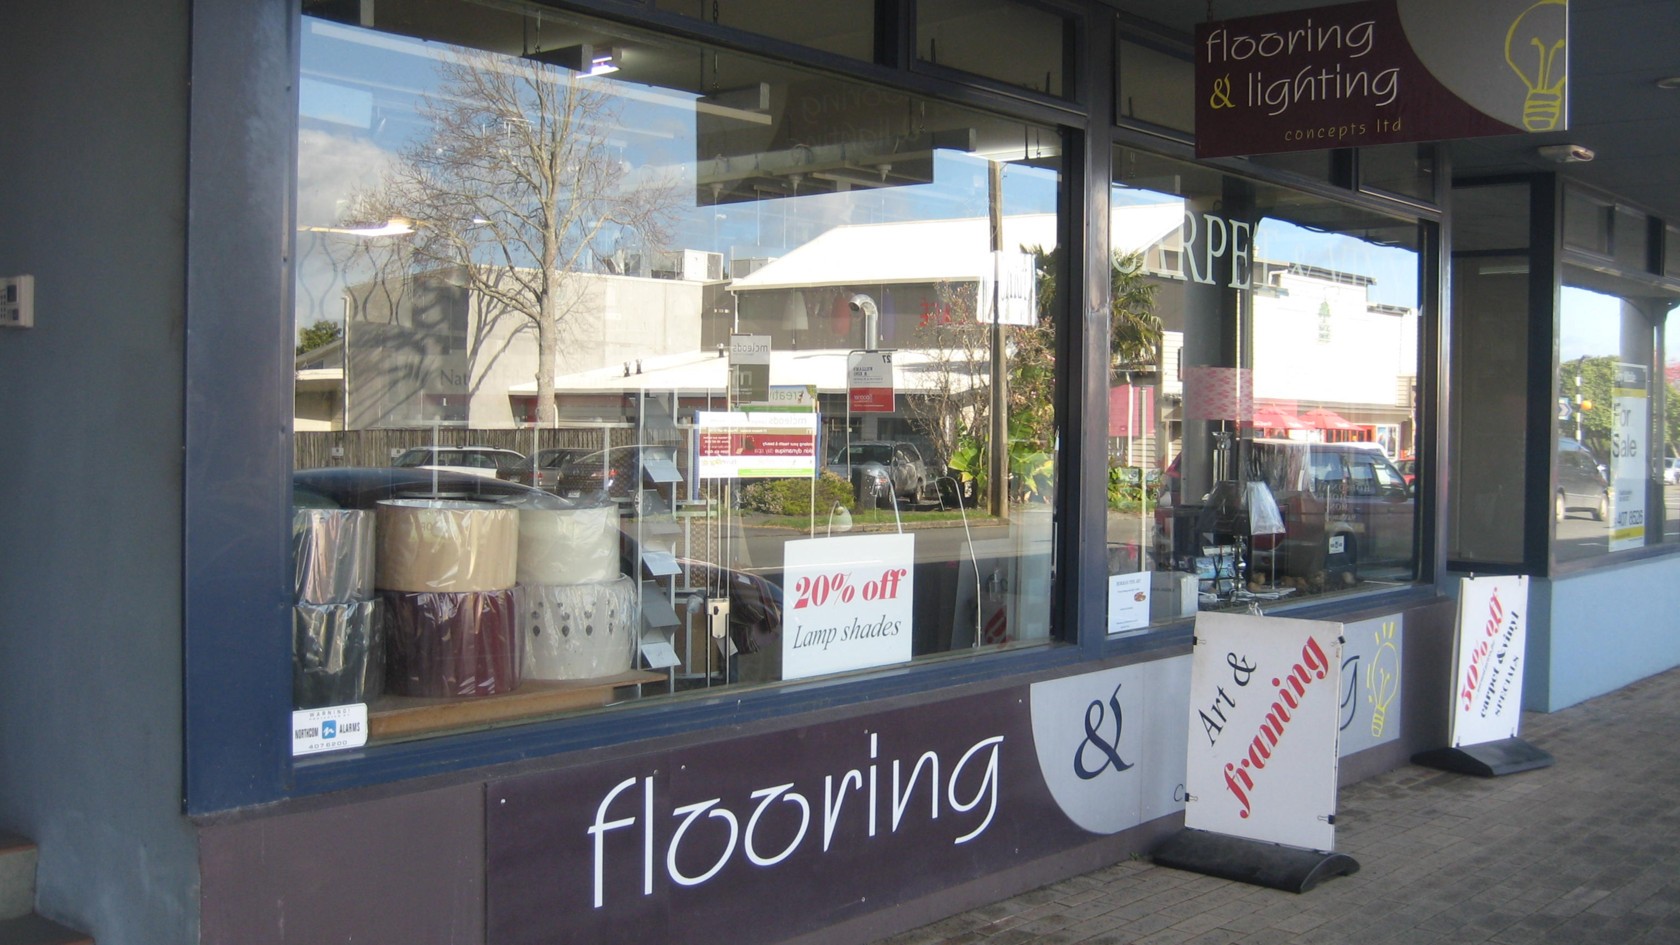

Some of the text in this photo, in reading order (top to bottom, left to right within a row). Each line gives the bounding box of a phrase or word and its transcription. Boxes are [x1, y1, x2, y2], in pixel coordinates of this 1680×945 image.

[1206, 19, 1375, 63] flooring
[1210, 64, 1399, 115] & lighting
[1284, 118, 1401, 141] concepts ltd
[1613, 403, 1631, 427] For
[1612, 433, 1638, 458] Sale
[793, 568, 907, 609] 20% off
[793, 614, 902, 650] Lamp shades
[1460, 640, 1488, 712] 50%
[1485, 587, 1503, 637] off
[1481, 668, 1500, 718] carpet
[1497, 651, 1506, 664] &
[1503, 611, 1519, 648] vinyl
[1495, 656, 1519, 716] SPECIALS
[1198, 652, 1257, 747] Art &
[308, 740, 348, 749] 4076200
[340, 722, 361, 734] ALARMS
[1223, 635, 1329, 819] framing
[587, 683, 1135, 908] flooring &
